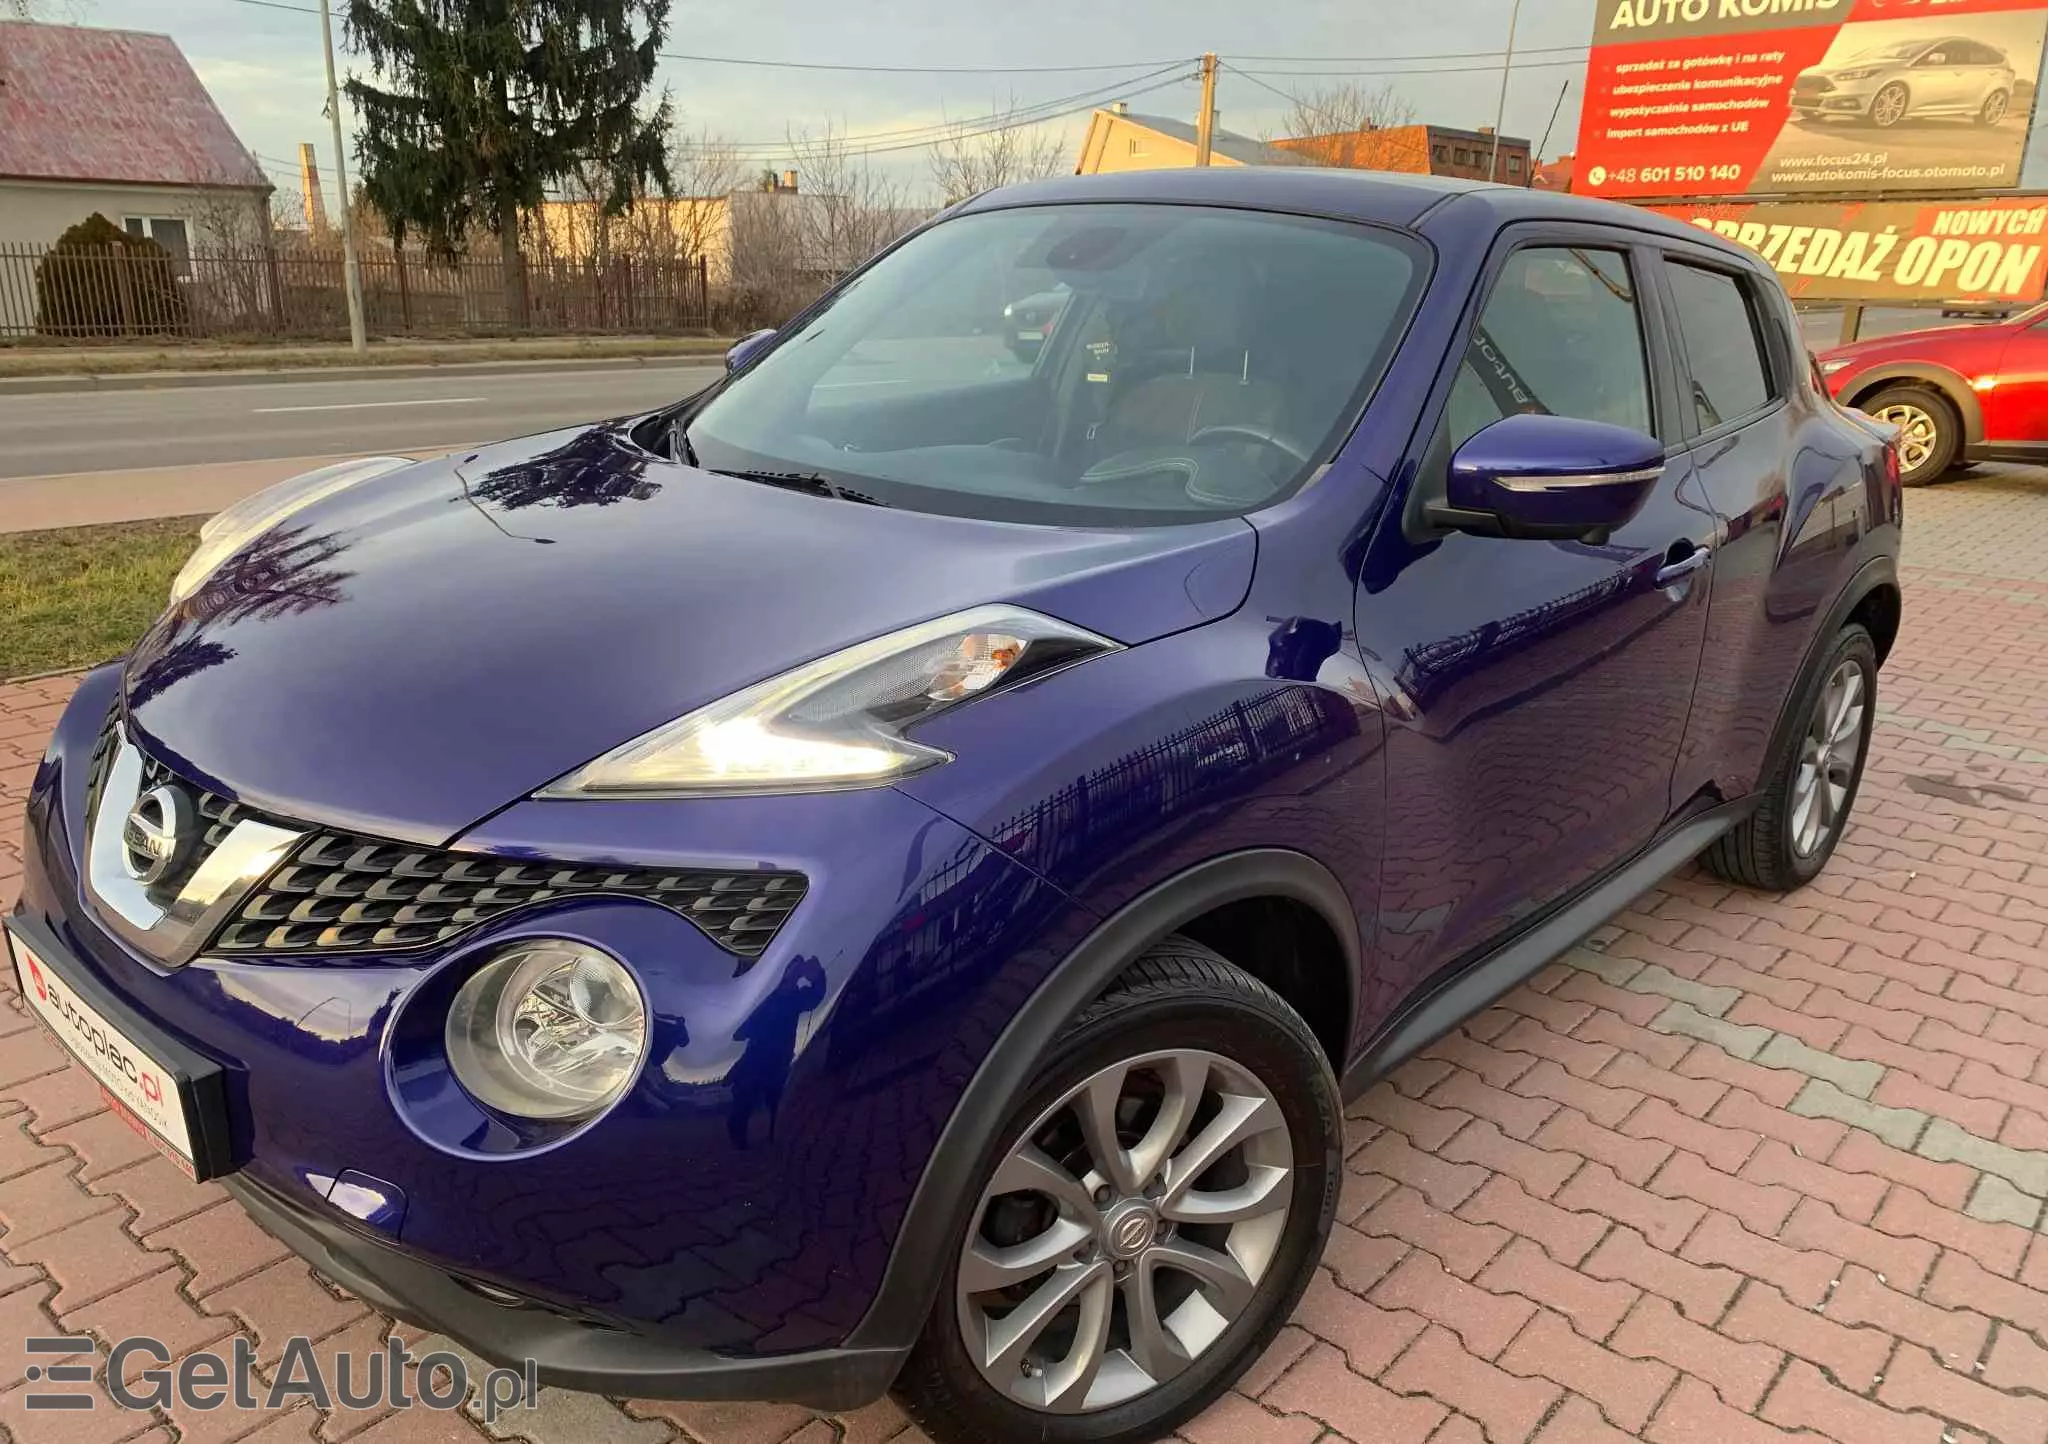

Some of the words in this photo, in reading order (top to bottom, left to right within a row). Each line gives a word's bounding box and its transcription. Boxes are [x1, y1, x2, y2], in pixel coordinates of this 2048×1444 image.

[1609, 0, 1709, 29] AUTO
[1742, 54, 1758, 64] na
[1760, 51, 1785, 64] raty
[1693, 74, 1784, 88] komunikacyjne
[1691, 98, 1770, 112] samochodów
[1606, 127, 1642, 140] import
[1644, 122, 1719, 137] samochodów
[1730, 121, 1749, 132] UE
[1780, 152, 1888, 168] www.focus24.pl
[1608, 168, 1637, 183] +48
[1640, 167, 1670, 182] 601
[1673, 166, 1705, 181] 510
[1709, 164, 1741, 180] 140
[1771, 163, 2006, 183] www.autokomis-focus.otomoto.pl
[1931, 208, 2047, 236] NOWYCH
[1690, 217, 1899, 282] RZEDAŻ
[1893, 235, 2041, 295] OPON
[47, 983, 164, 1107] autoplac.pl
